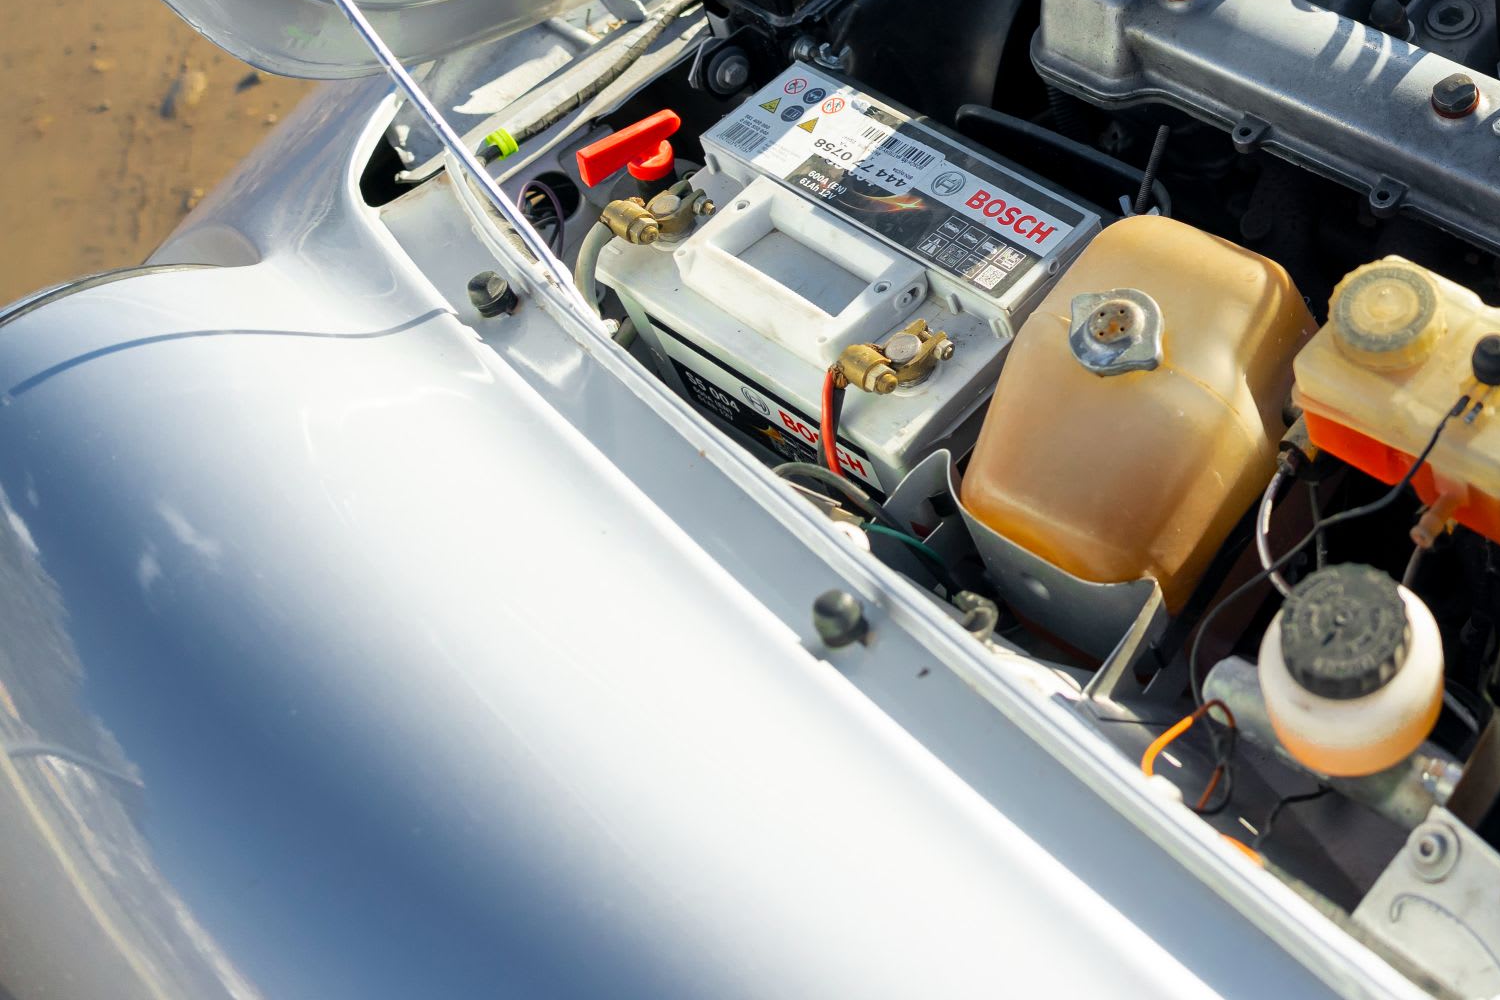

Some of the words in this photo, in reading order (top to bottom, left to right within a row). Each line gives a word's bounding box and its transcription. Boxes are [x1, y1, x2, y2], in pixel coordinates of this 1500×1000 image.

[814, 138, 853, 161] 0758
[799, 178, 820, 192] 61Ah
[818, 188, 836, 200] 12V
[808, 170, 830, 185] 600A
[827, 181, 847, 195] (EN)
[874, 168, 907, 189] 444
[965, 189, 1057, 245] BOSCH
[685, 370, 706, 391] S5
[709, 386, 740, 412] 004
[778, 410, 868, 478] BOCH
